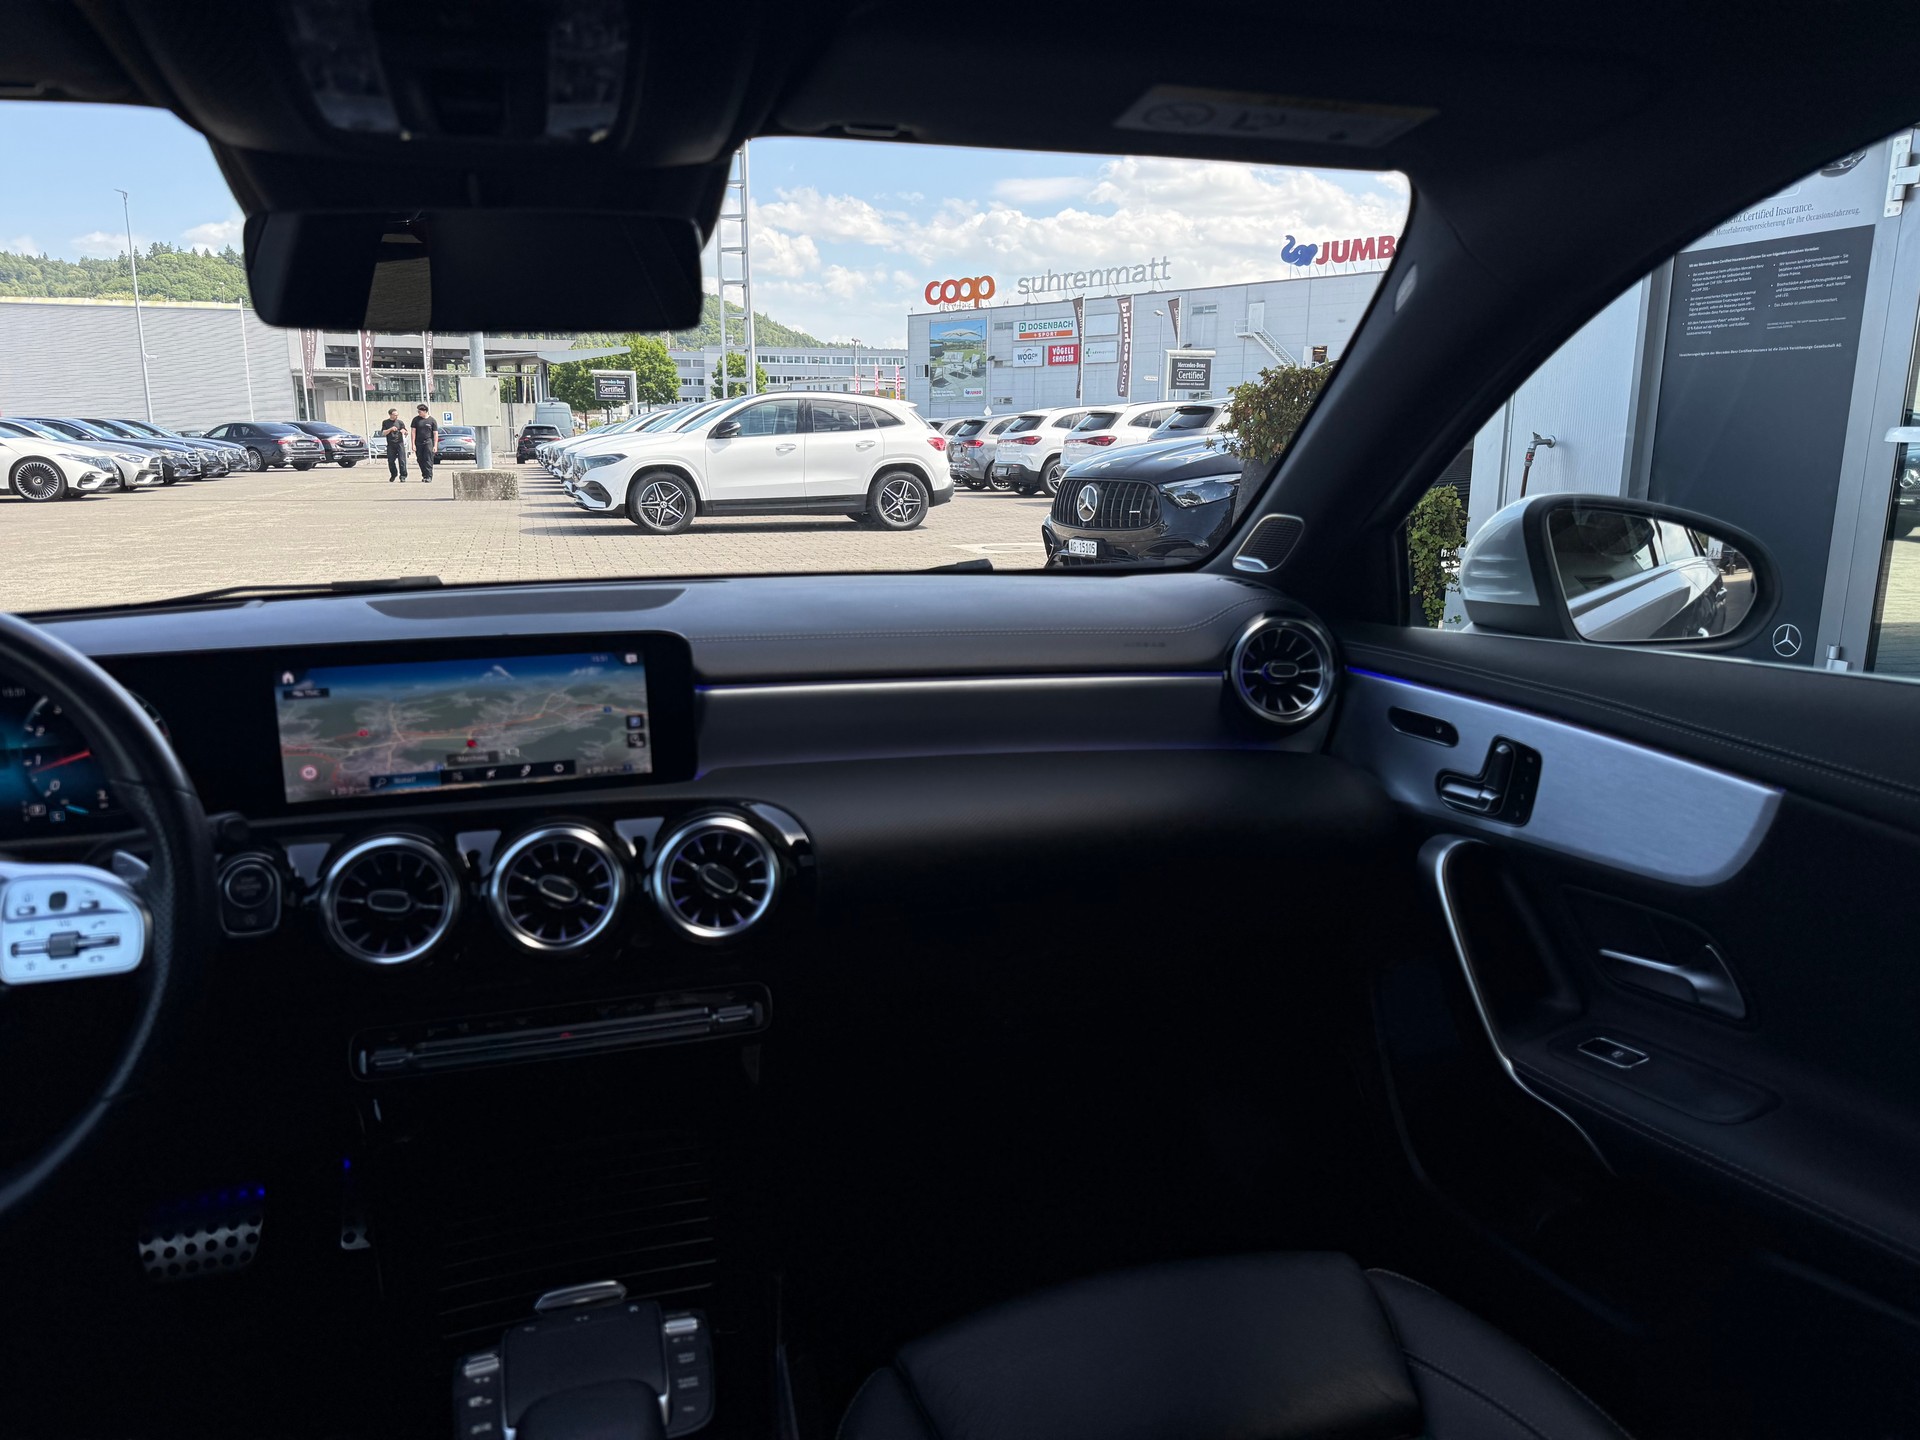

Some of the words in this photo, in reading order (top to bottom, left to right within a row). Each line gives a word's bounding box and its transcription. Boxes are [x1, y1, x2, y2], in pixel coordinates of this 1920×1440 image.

[1743, 208, 1774, 222] Certified
[1775, 203, 1814, 217] Insurance.
[1786, 215, 1795, 225] für
[1315, 235, 1397, 265] JUMB
[1017, 255, 1172, 294] suhrenmatt
[924, 275, 996, 308] coop
[1028, 320, 1074, 330] DOSENBACH
[1052, 347, 1075, 355] VÖGELE
[1178, 371, 1204, 380] Certified
[601, 385, 624, 393] Certified
